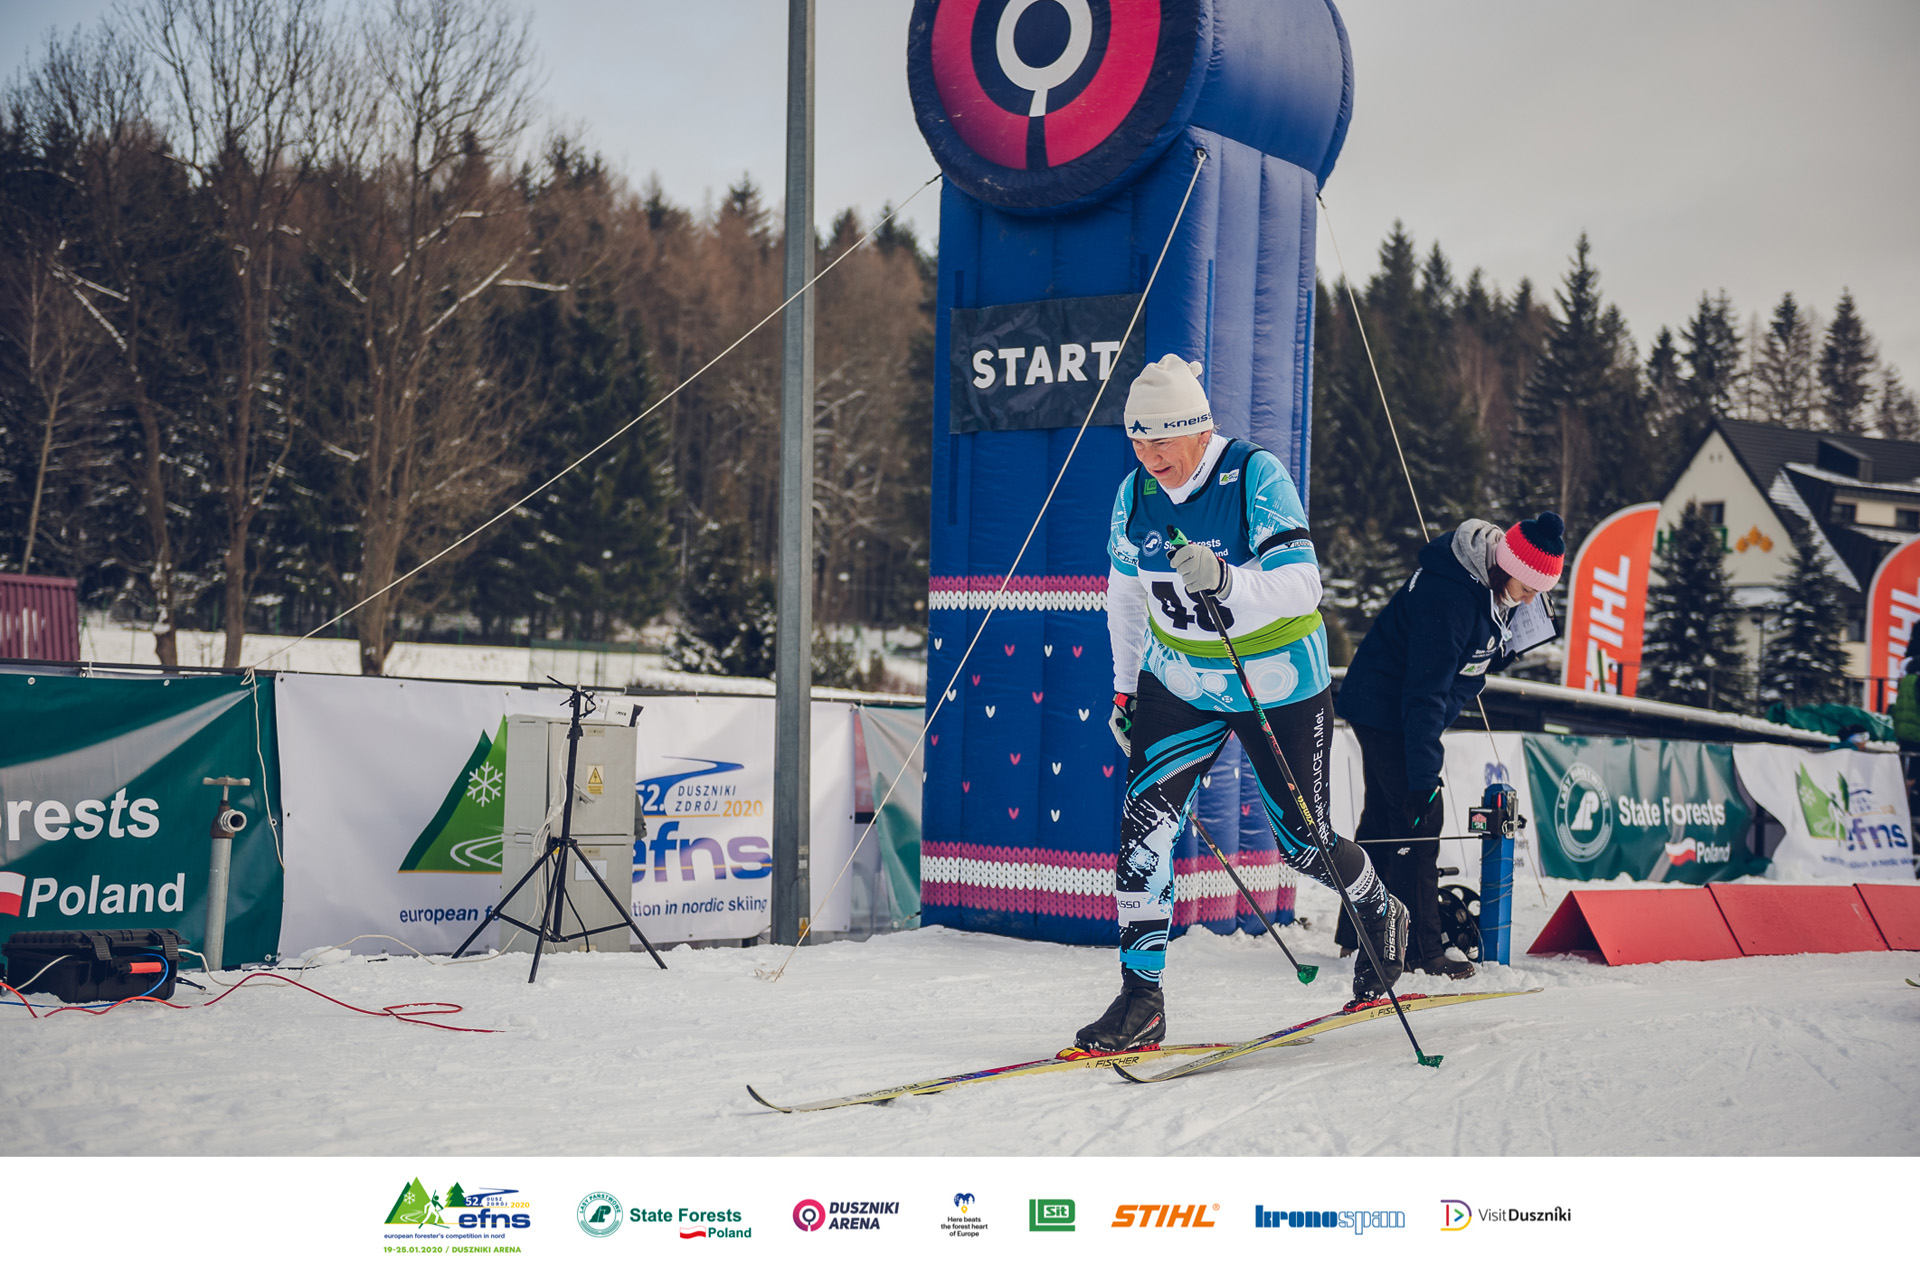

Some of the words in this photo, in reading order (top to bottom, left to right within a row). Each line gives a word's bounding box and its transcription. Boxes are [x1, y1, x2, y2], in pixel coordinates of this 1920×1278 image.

[972, 341, 1120, 389] START
[1151, 581, 1235, 632] 48
[678, 785, 736, 797] DUSZNIKI
[1312, 749, 1324, 803] POLICE
[0, 788, 160, 841] rests
[675, 799, 718, 812] ZDRÓJ
[722, 800, 763, 817] 2020
[1618, 795, 1661, 826] State
[1662, 797, 1726, 826] Forests
[1696, 842, 1730, 864] Poland
[27, 873, 185, 918] Poland
[400, 908, 479, 925] european
[665, 900, 677, 915] in
[682, 897, 724, 914] nordic
[728, 896, 767, 913] skiing
[1377, 1003, 1412, 1017] FISCER
[1095, 1056, 1140, 1068] FISCHER
